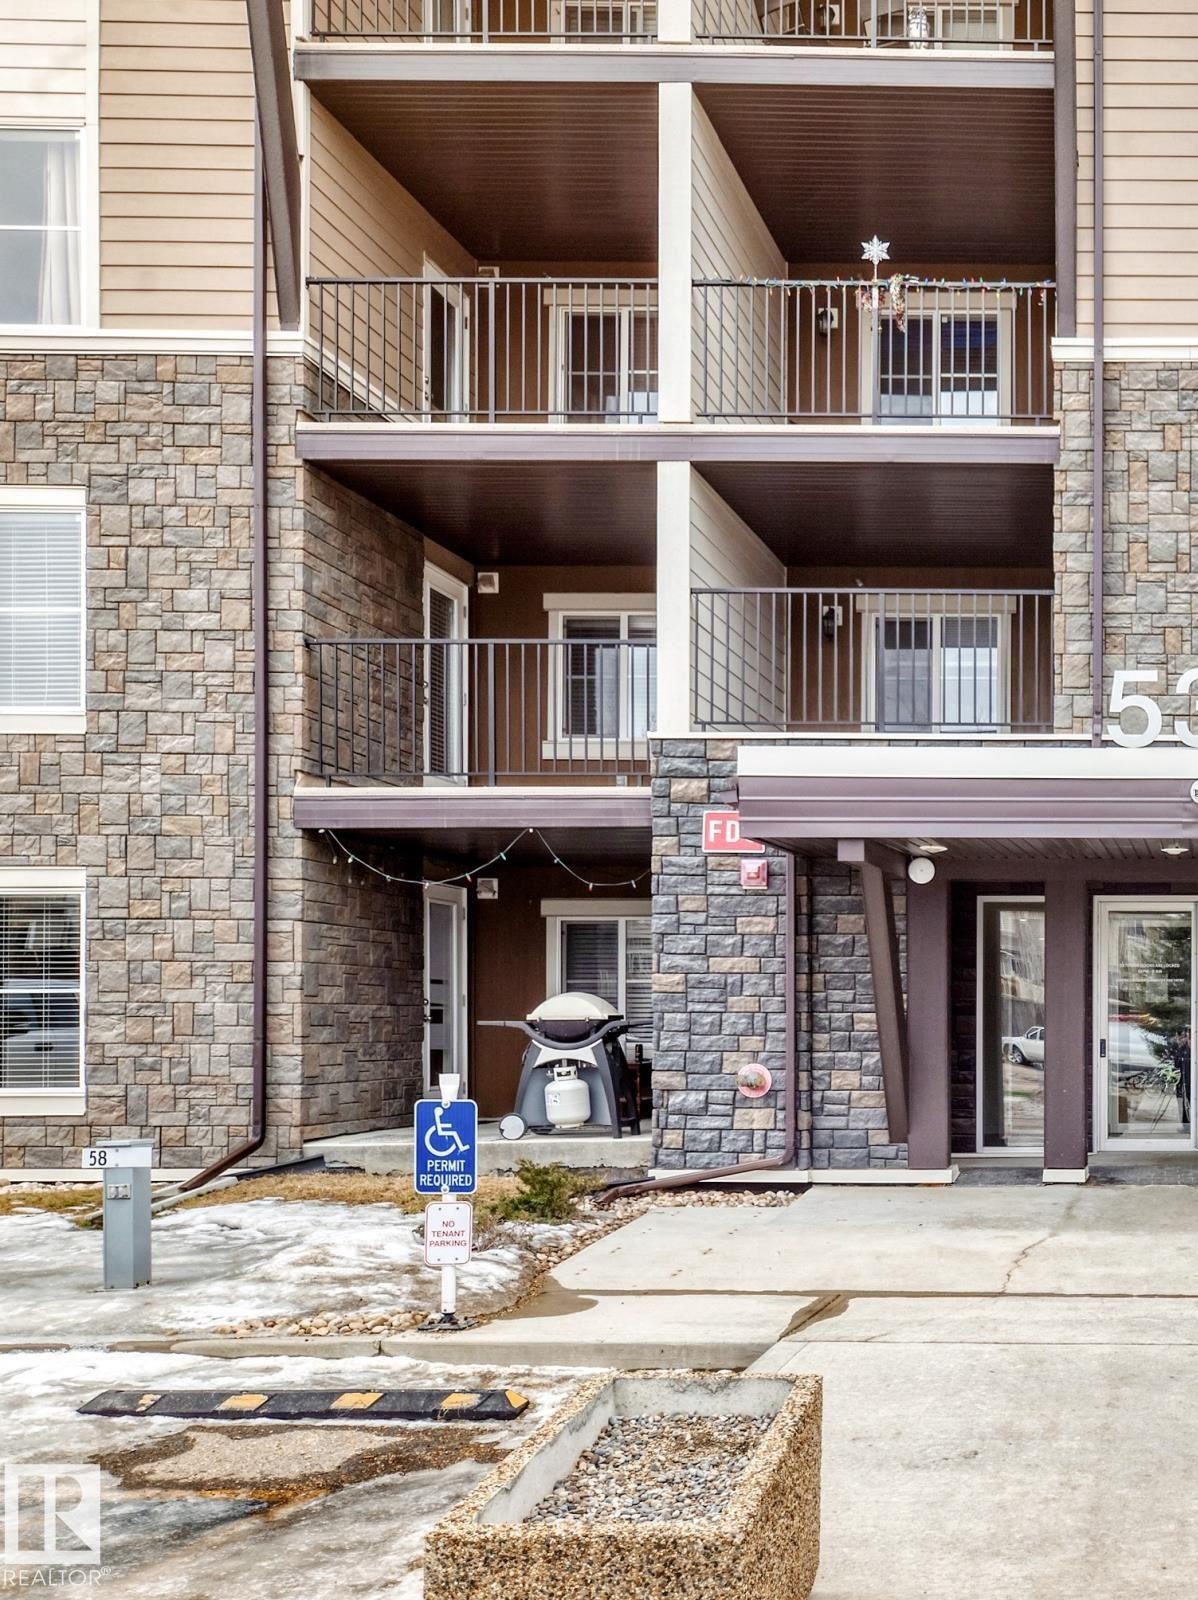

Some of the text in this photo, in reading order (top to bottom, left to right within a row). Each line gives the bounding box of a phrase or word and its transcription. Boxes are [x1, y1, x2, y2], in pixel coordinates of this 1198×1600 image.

[708, 820, 741, 843] FD
[89, 1150, 107, 1166] 58
[427, 1160, 466, 1172] PERMIT
[420, 1173, 473, 1187] REQUIRED
[442, 1220, 455, 1228] NO
[431, 1230, 466, 1238] TENANT
[429, 1239, 468, 1248] PARKING
